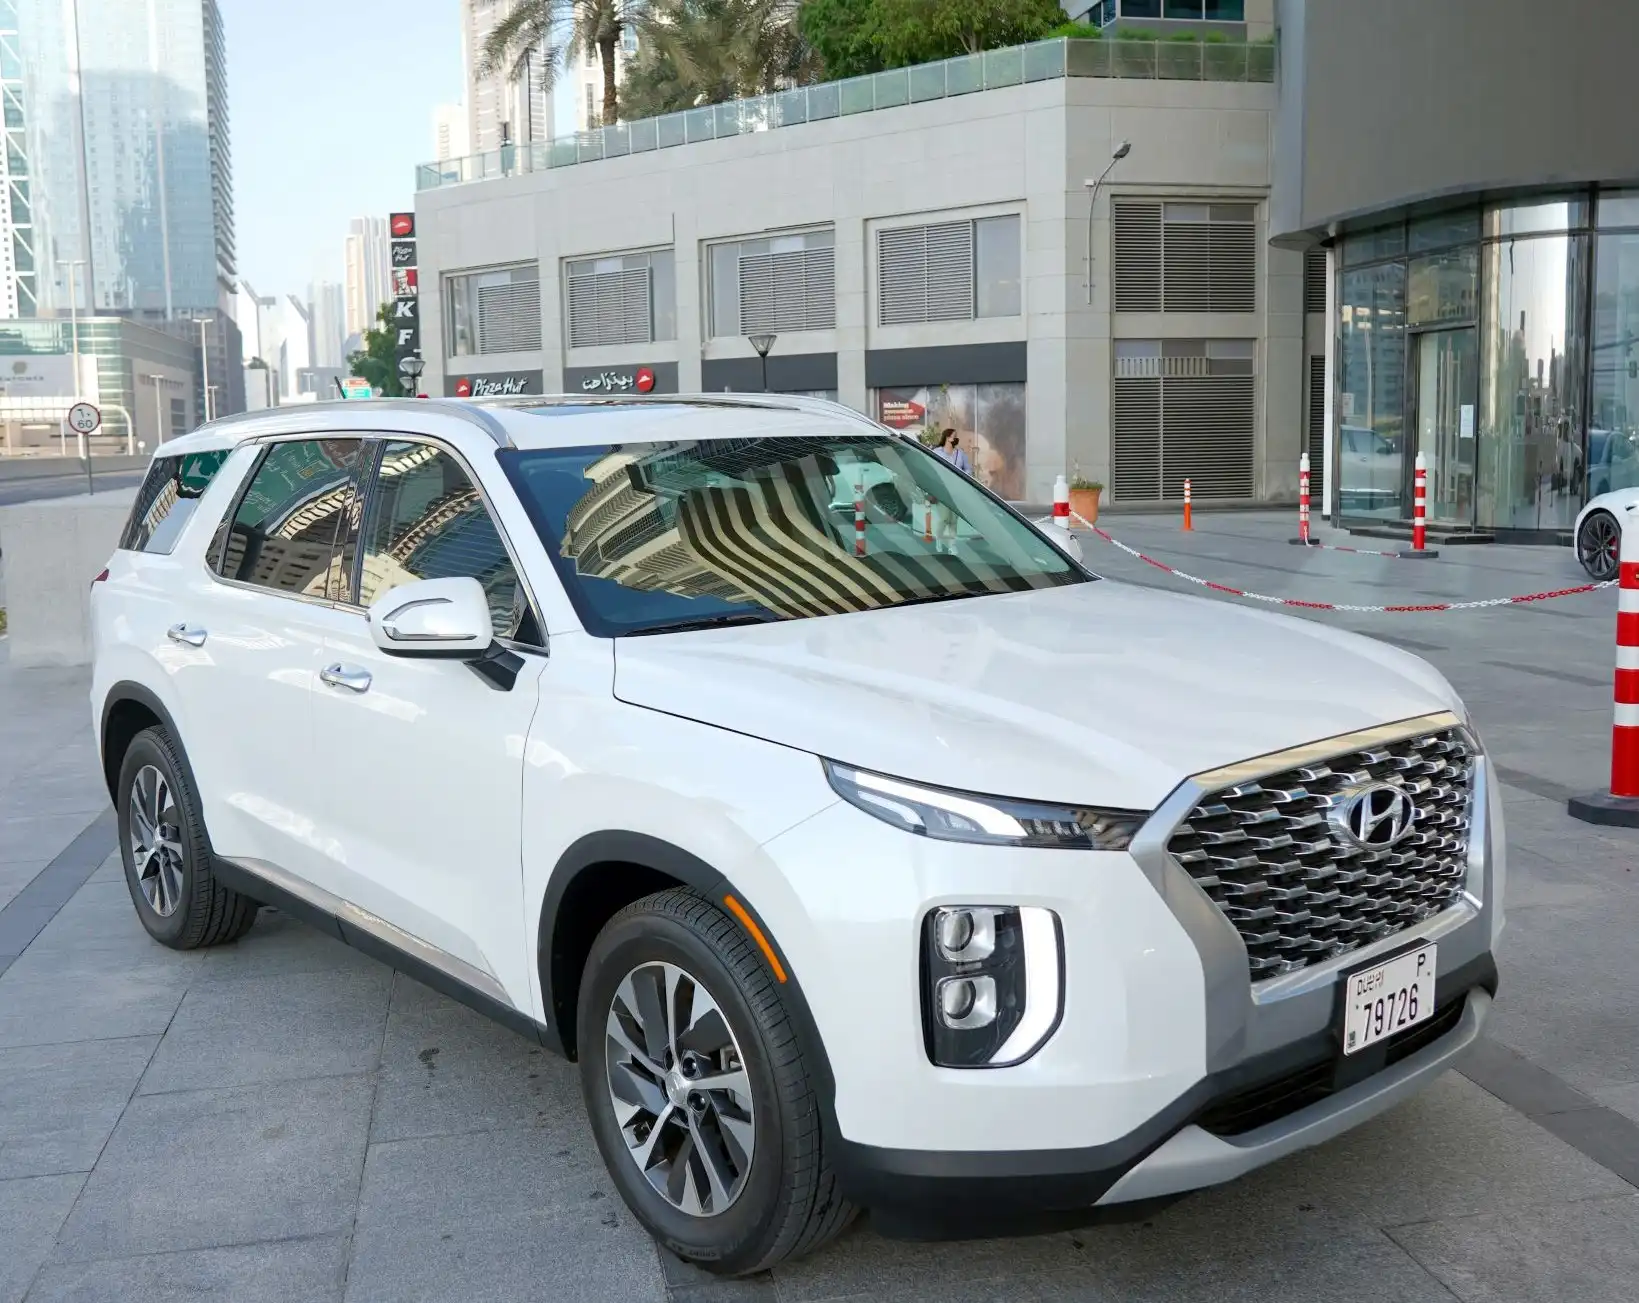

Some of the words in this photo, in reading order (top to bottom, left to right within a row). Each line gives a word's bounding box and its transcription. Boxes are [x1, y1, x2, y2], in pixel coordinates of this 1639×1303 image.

[472, 378, 502, 396] Pizza
[502, 377, 527, 395] Hut
[77, 419, 93, 429] 60
[1416, 952, 1426, 977] P
[1363, 982, 1418, 1042] 79726
